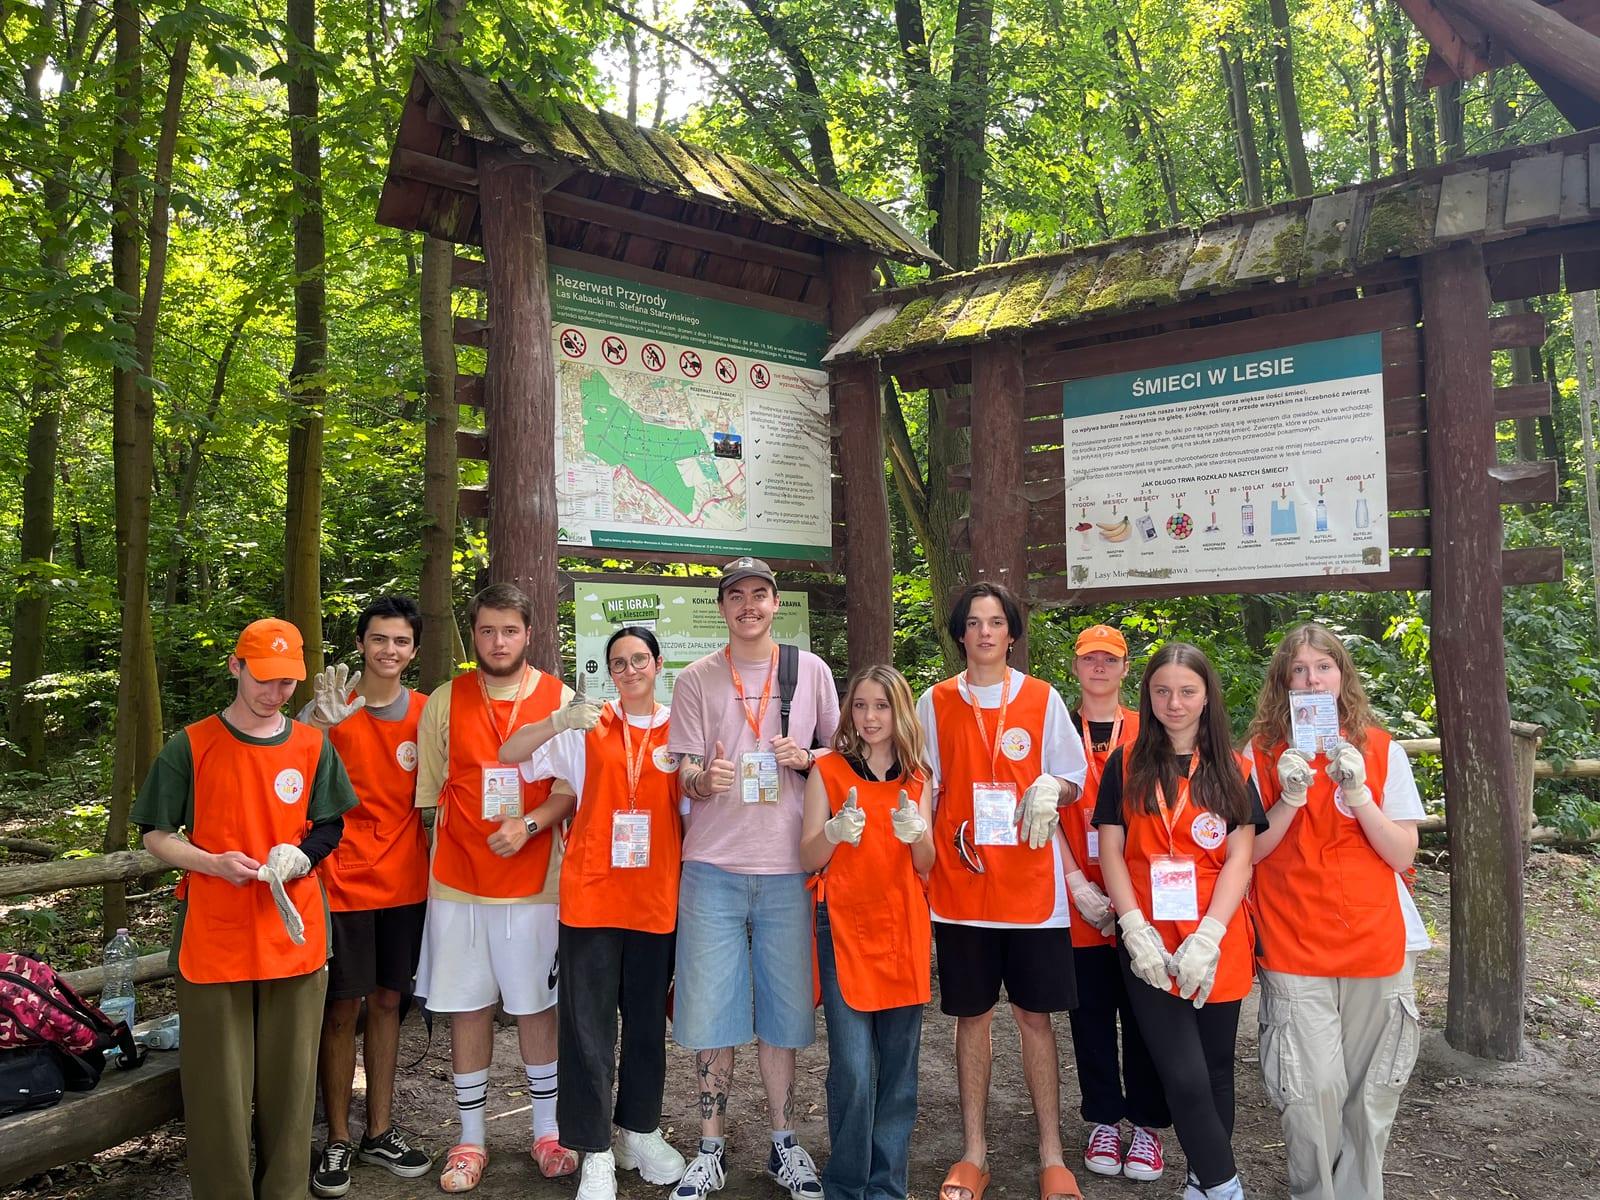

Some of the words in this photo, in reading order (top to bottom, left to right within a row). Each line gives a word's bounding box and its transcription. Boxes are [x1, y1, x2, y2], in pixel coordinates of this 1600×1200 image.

[556, 274, 613, 296] Rezerwat
[616, 286, 667, 309] Przyrody
[556, 289, 571, 299] Las
[572, 292, 604, 306] Kabacki
[606, 298, 618, 308] im.
[620, 301, 649, 315] Stefana
[649, 308, 700, 325] Starzyńskiego
[1132, 371, 1201, 397] ŚMIECI
[1208, 368, 1226, 386] W
[1233, 357, 1294, 382] LESIE
[1197, 473, 1227, 481] ROZKŁAD
[1229, 470, 1259, 478] NASZYCH
[1262, 466, 1288, 474] ŚMIECI?
[1346, 474, 1361, 482] 4000
[1103, 498, 1128, 506] MIESIĘCY
[1133, 494, 1159, 503] MIESIĘCY
[1072, 501, 1095, 509] TYGODNI
[1095, 572, 1111, 580] Lasy
[608, 600, 624, 611] NIE
[626, 598, 654, 610] IGRAJ
[624, 610, 654, 618] kleszczem
